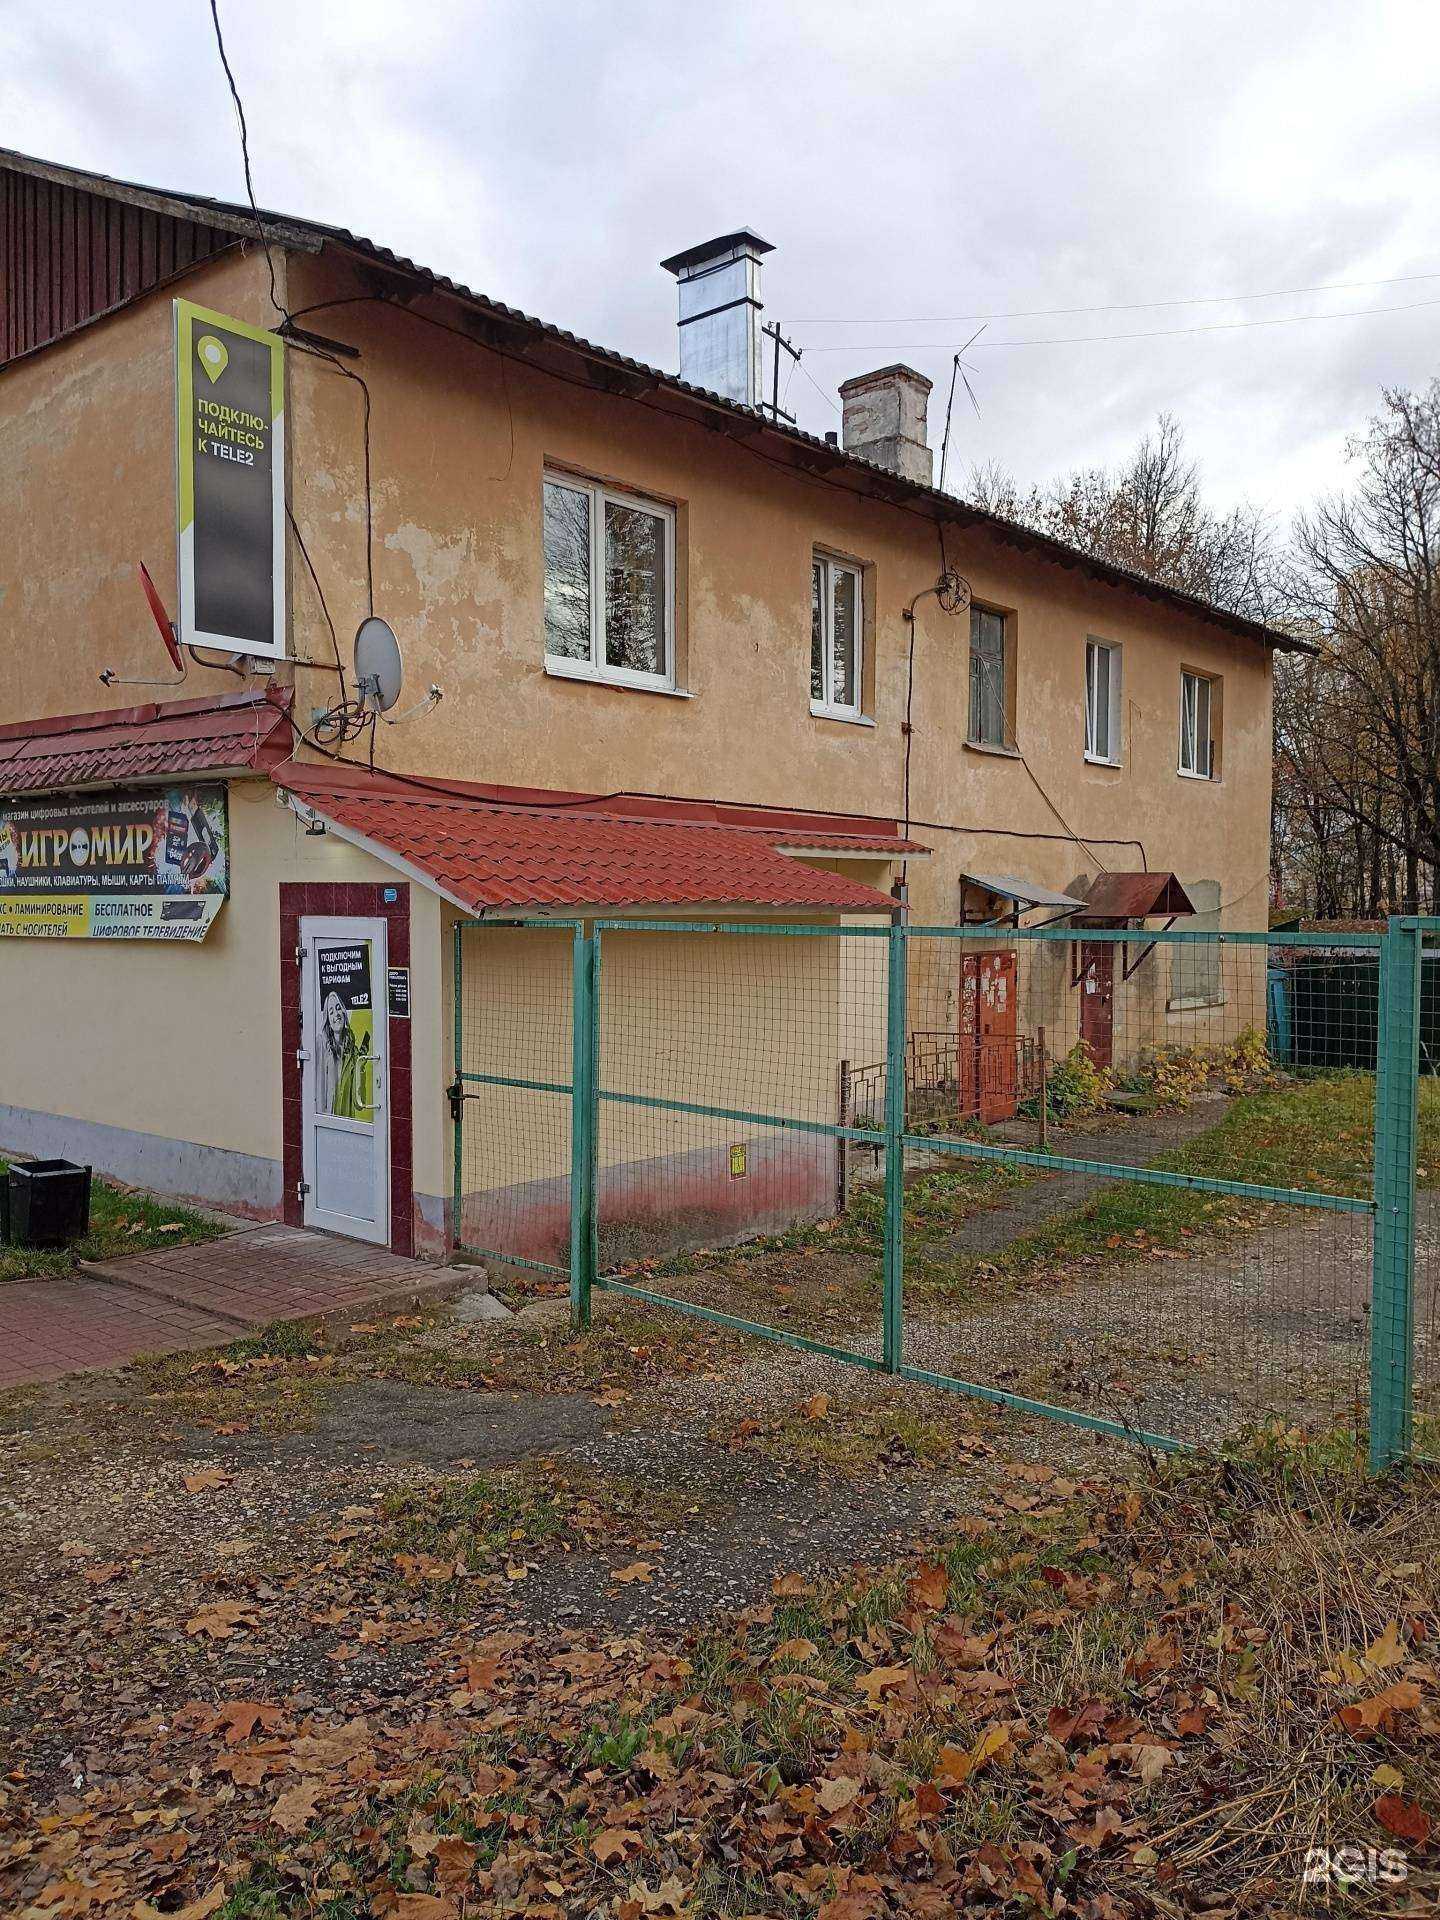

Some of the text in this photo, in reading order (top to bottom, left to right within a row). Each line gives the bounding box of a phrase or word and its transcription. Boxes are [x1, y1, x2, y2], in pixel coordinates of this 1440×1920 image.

[198, 398, 269, 432] ПОДКЛЮ-
[198, 418, 265, 450] ЧАЙТЕСЬ
[198, 438, 254, 466] К TELE2
[31, 807, 68, 820] цифровых
[70, 800, 110, 816] носителей
[111, 802, 117, 811] и
[20, 824, 153, 868] ИГРОМИР
[16, 876, 53, 887] НАУШНИКИ,
[53, 874, 100, 887] КЛАВИАТУРЫ,
[101, 873, 128, 887] МЫШИ,
[129, 873, 155, 886] КАРТЫ
[15, 903, 84, 916] ЛАМИНИРОВАНИЕ
[95, 903, 153, 917] БЕСПЛАТНОЕ
[16, 923, 22, 935] С
[23, 921, 68, 936] НОСИТЕЛЕЙ
[92, 925, 208, 939] ЦИФРОВОЕ ТЕЛЕВИДЕНИЕ
[321, 951, 361, 962] ПОДКЛЮЧИМ
[321, 962, 362, 973] К ВЫГОДНЫМ
[322, 975, 350, 984] ТАРИФАМ
[351, 993, 369, 1004] TELE2
